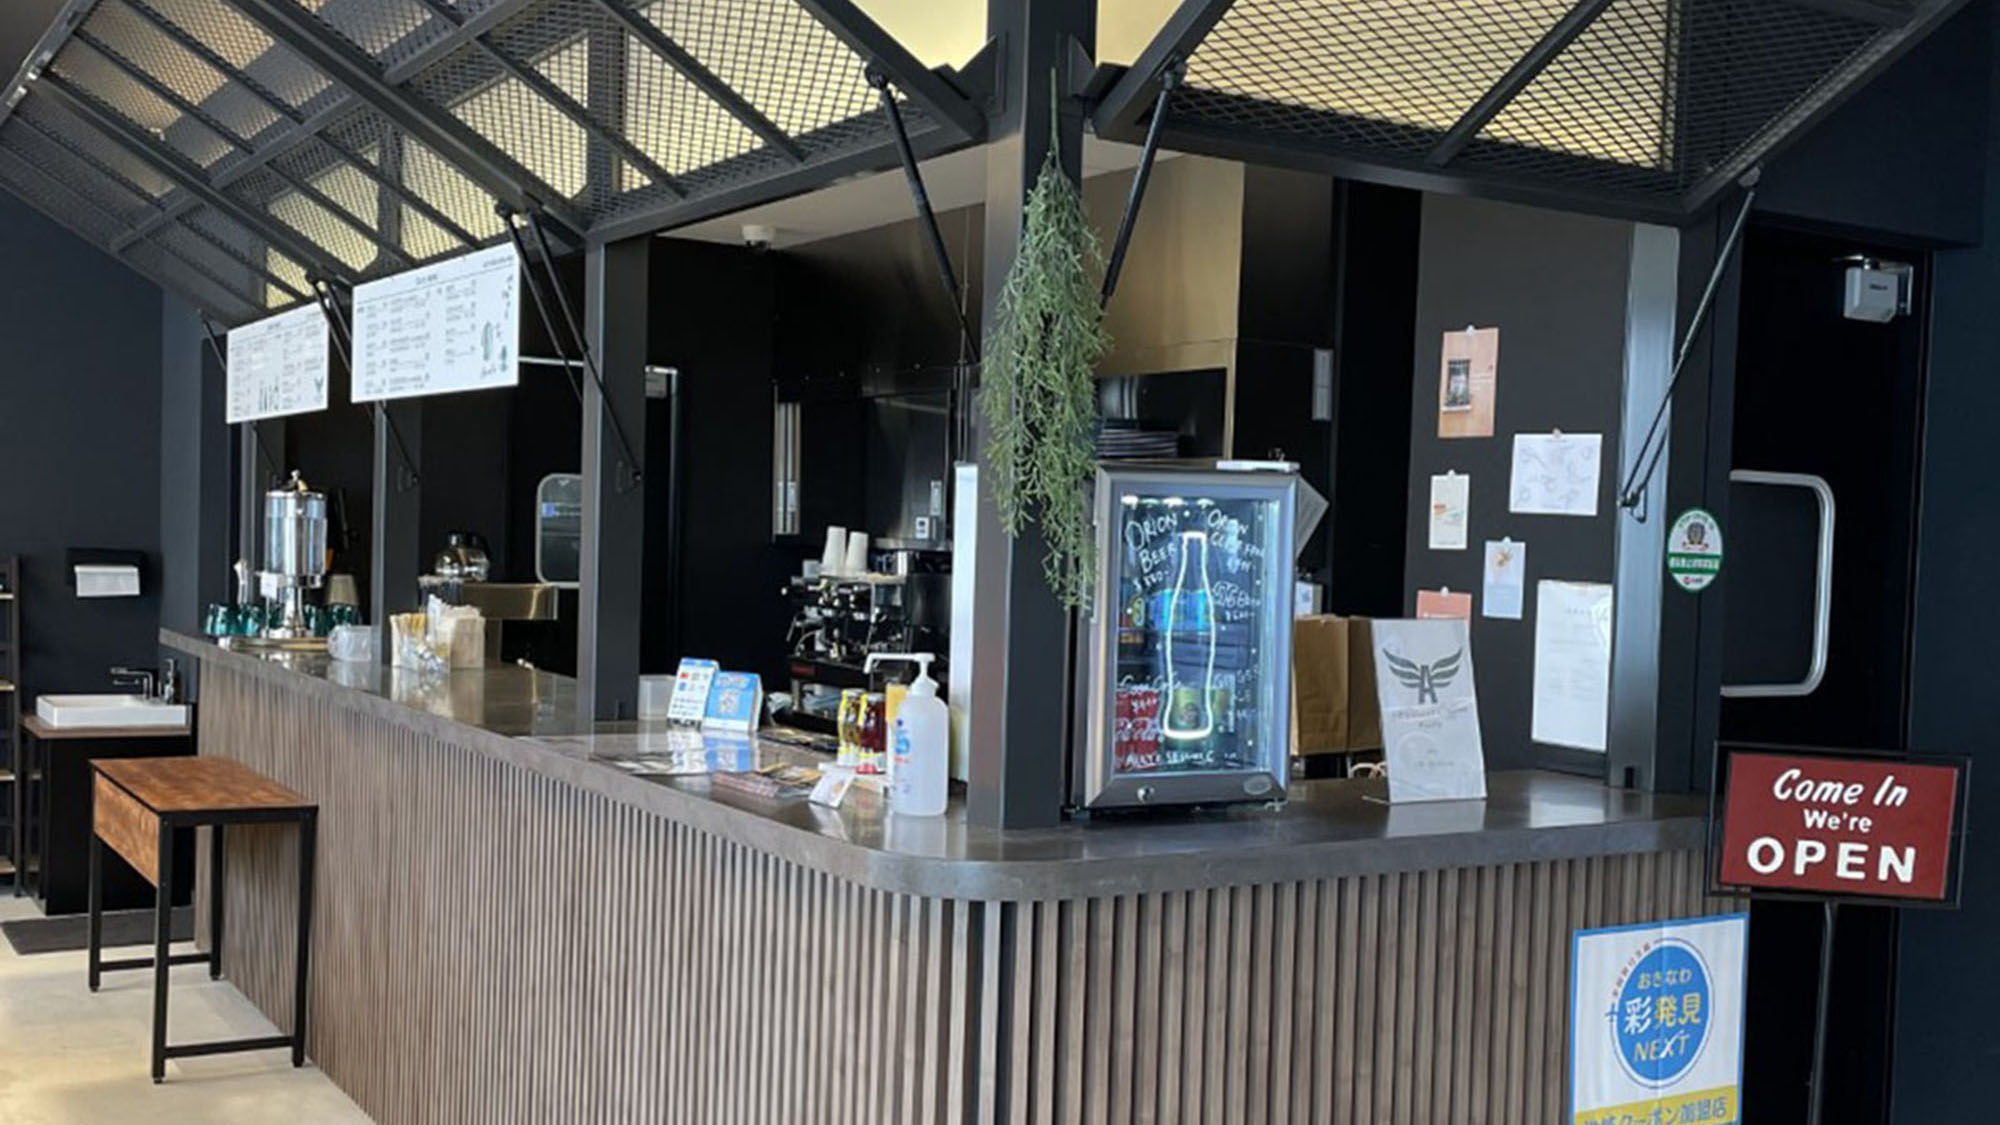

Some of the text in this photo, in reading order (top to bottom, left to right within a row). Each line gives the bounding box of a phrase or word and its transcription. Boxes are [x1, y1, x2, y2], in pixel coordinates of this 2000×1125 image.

[1125, 512, 1178, 551] ORION
[1138, 542, 1177, 574] BEER
[1773, 768, 1909, 807] Come In
[1803, 808, 1873, 834] We're
[1747, 836, 1917, 884] OPEN
[1637, 969, 1693, 990] おきなわ
[1624, 993, 1702, 1036] 彩発見
[1633, 1030, 1690, 1063] NEXT
